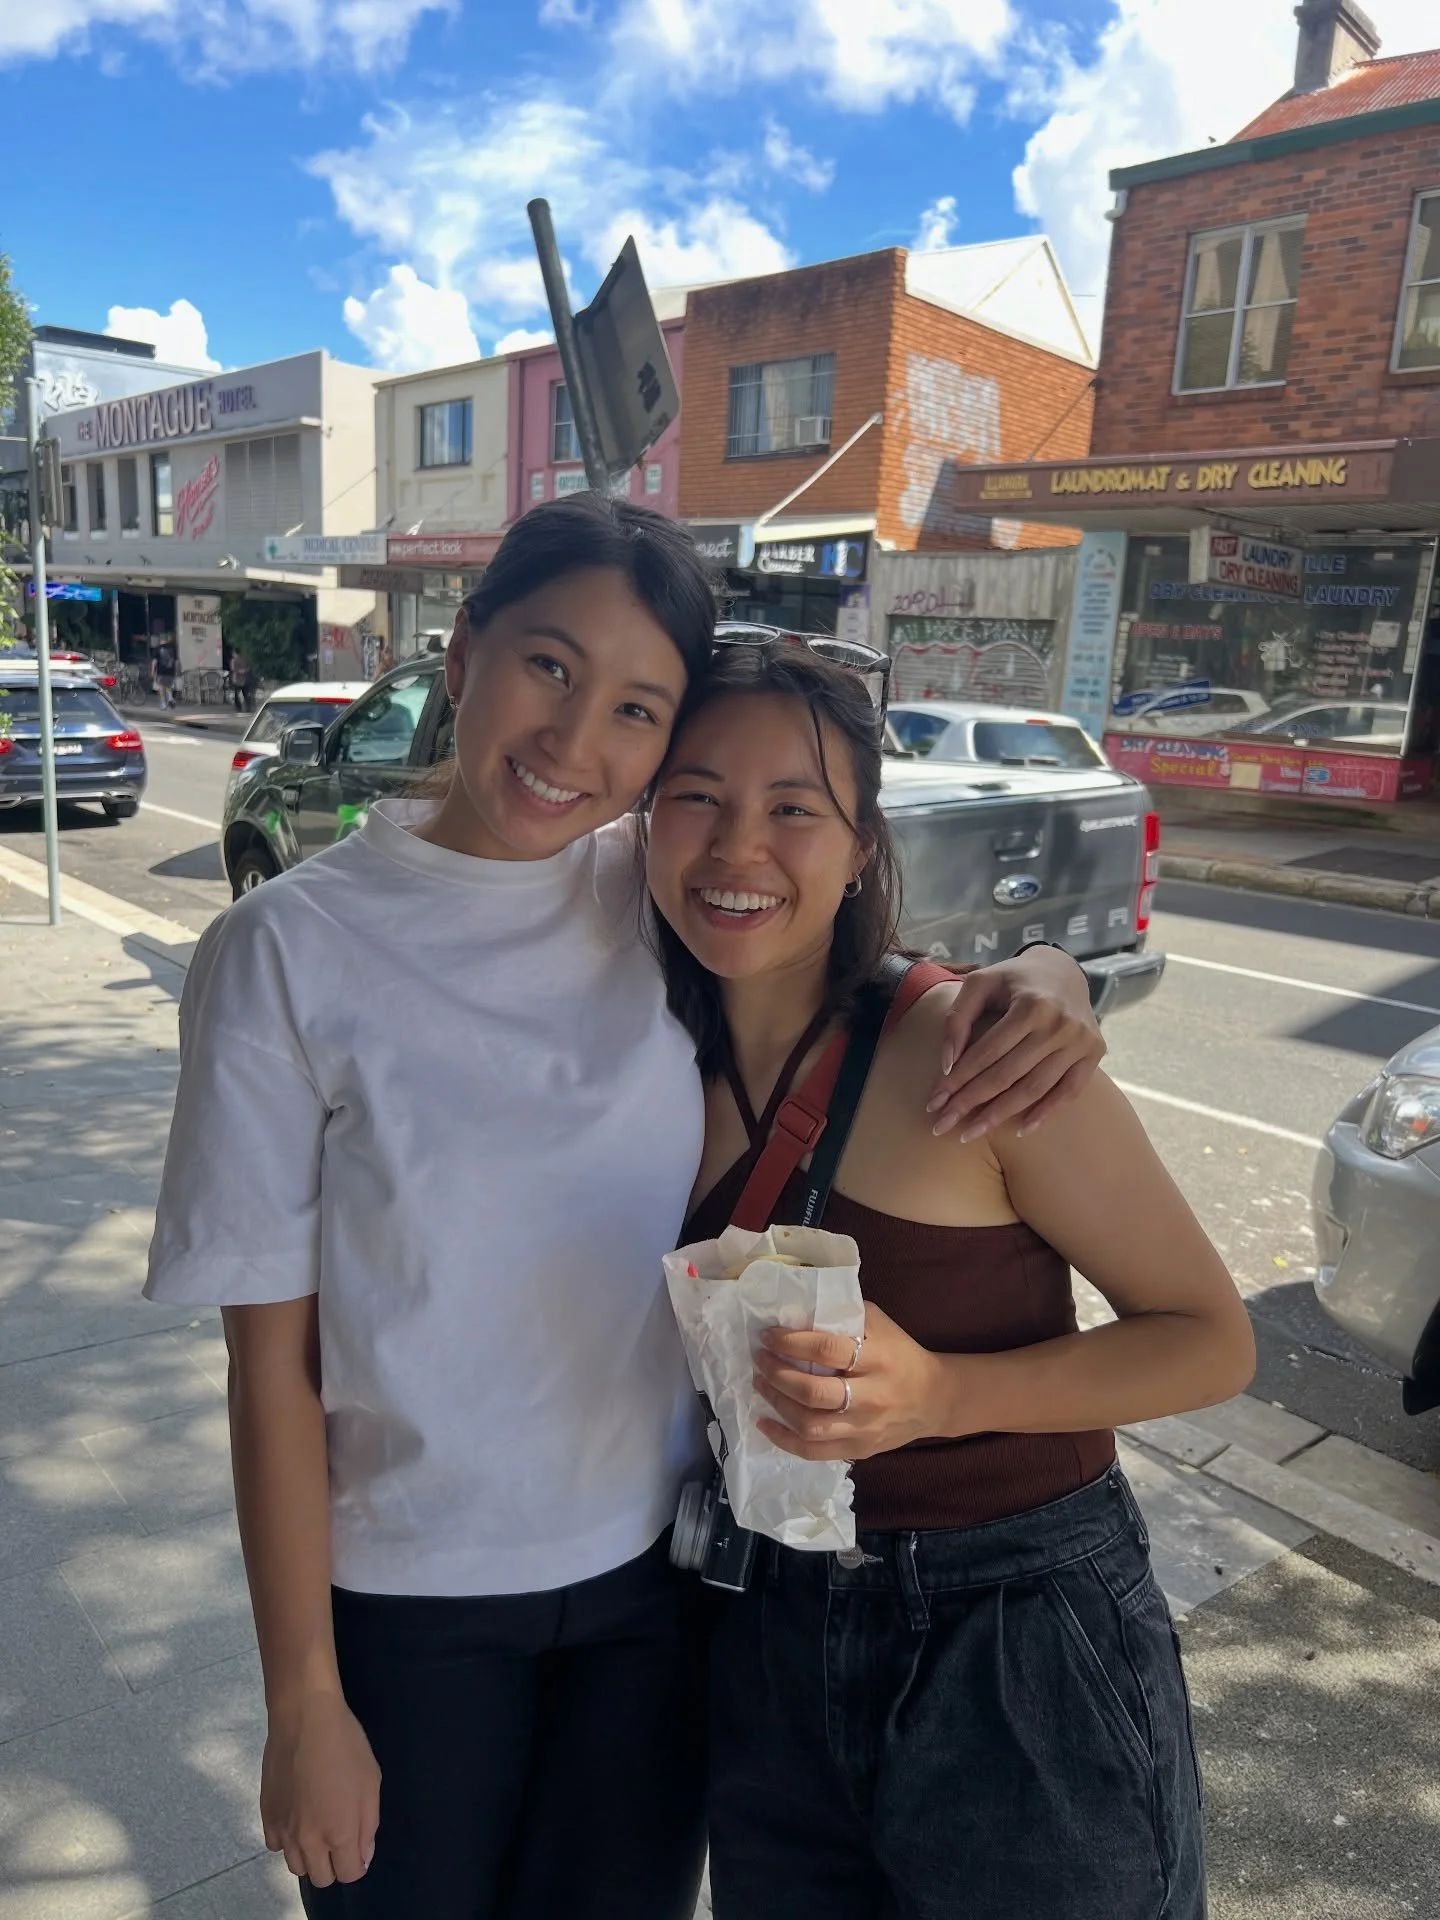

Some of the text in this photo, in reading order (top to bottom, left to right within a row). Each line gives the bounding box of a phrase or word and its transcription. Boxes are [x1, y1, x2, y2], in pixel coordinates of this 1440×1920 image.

[95, 383, 214, 449] MONTAGUE
[1051, 456, 1347, 495] LAUNDROMAT & DRY CLEANING
[402, 541, 440, 556] perfect
[441, 539, 463, 555] look
[760, 543, 816, 563] BARBER
[1242, 542, 1293, 568] LAUNDRY
[1219, 560, 1298, 593] DRY CLEANING
[1303, 585, 1400, 606] LAUNDRY
[1150, 757, 1217, 776] Special
[928, 907, 1129, 960] ANGER
[802, 1188, 819, 1226] FUJIFIL
